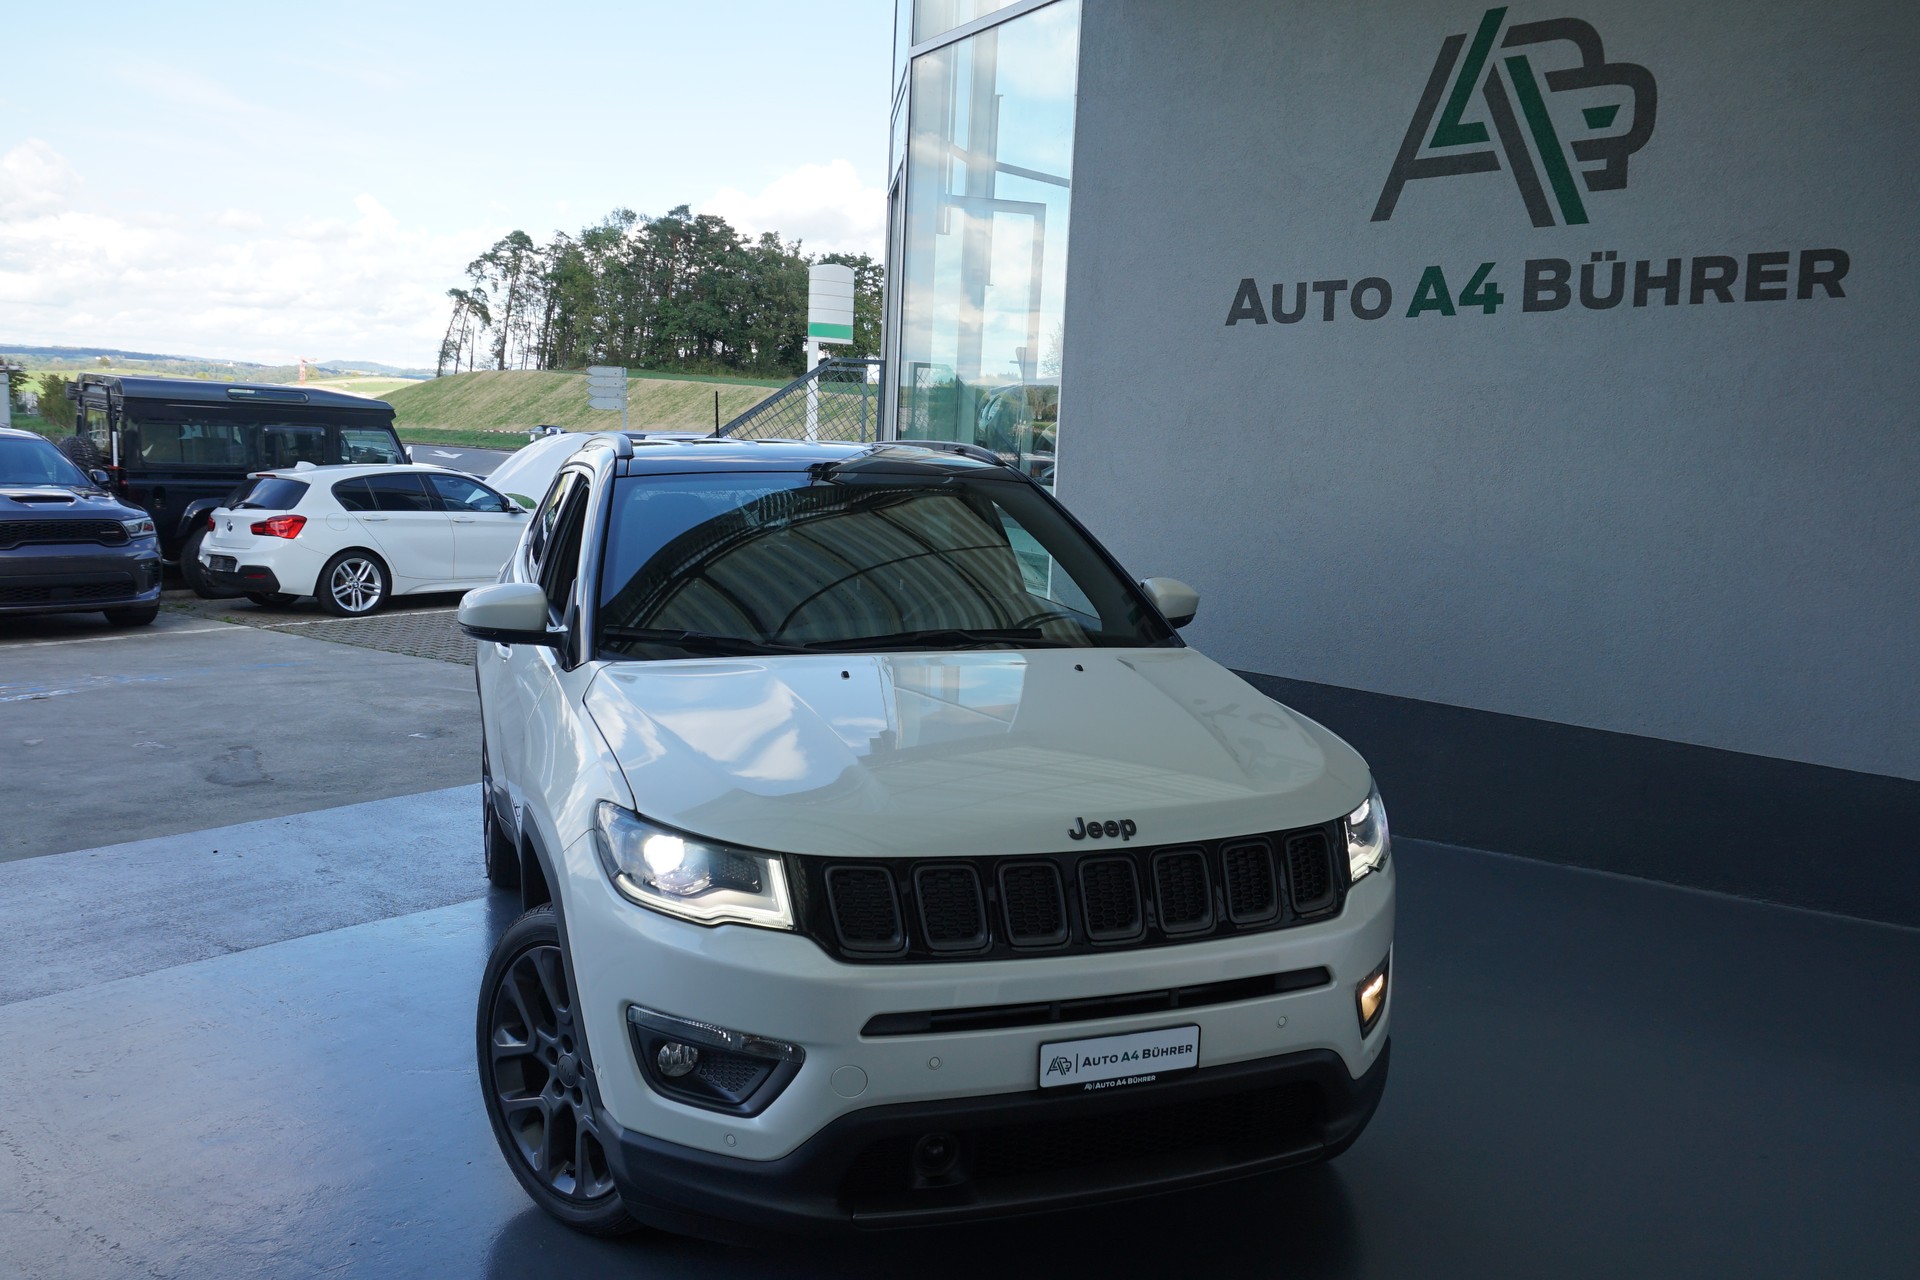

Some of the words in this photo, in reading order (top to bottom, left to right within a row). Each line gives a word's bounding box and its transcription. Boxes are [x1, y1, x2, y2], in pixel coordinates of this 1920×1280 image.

[1225, 277, 1393, 327] AUTO
[1405, 262, 1505, 318] A4
[1522, 248, 1851, 312] BÜHRER
[1067, 816, 1137, 841] Jeep
[1082, 1057, 1118, 1067] AUTO
[1121, 1051, 1139, 1062] A4
[1142, 1044, 1193, 1059] BÜHRER
[1095, 1081, 1115, 1089] AUTO
[1128, 1075, 1156, 1084] BÜHRER
